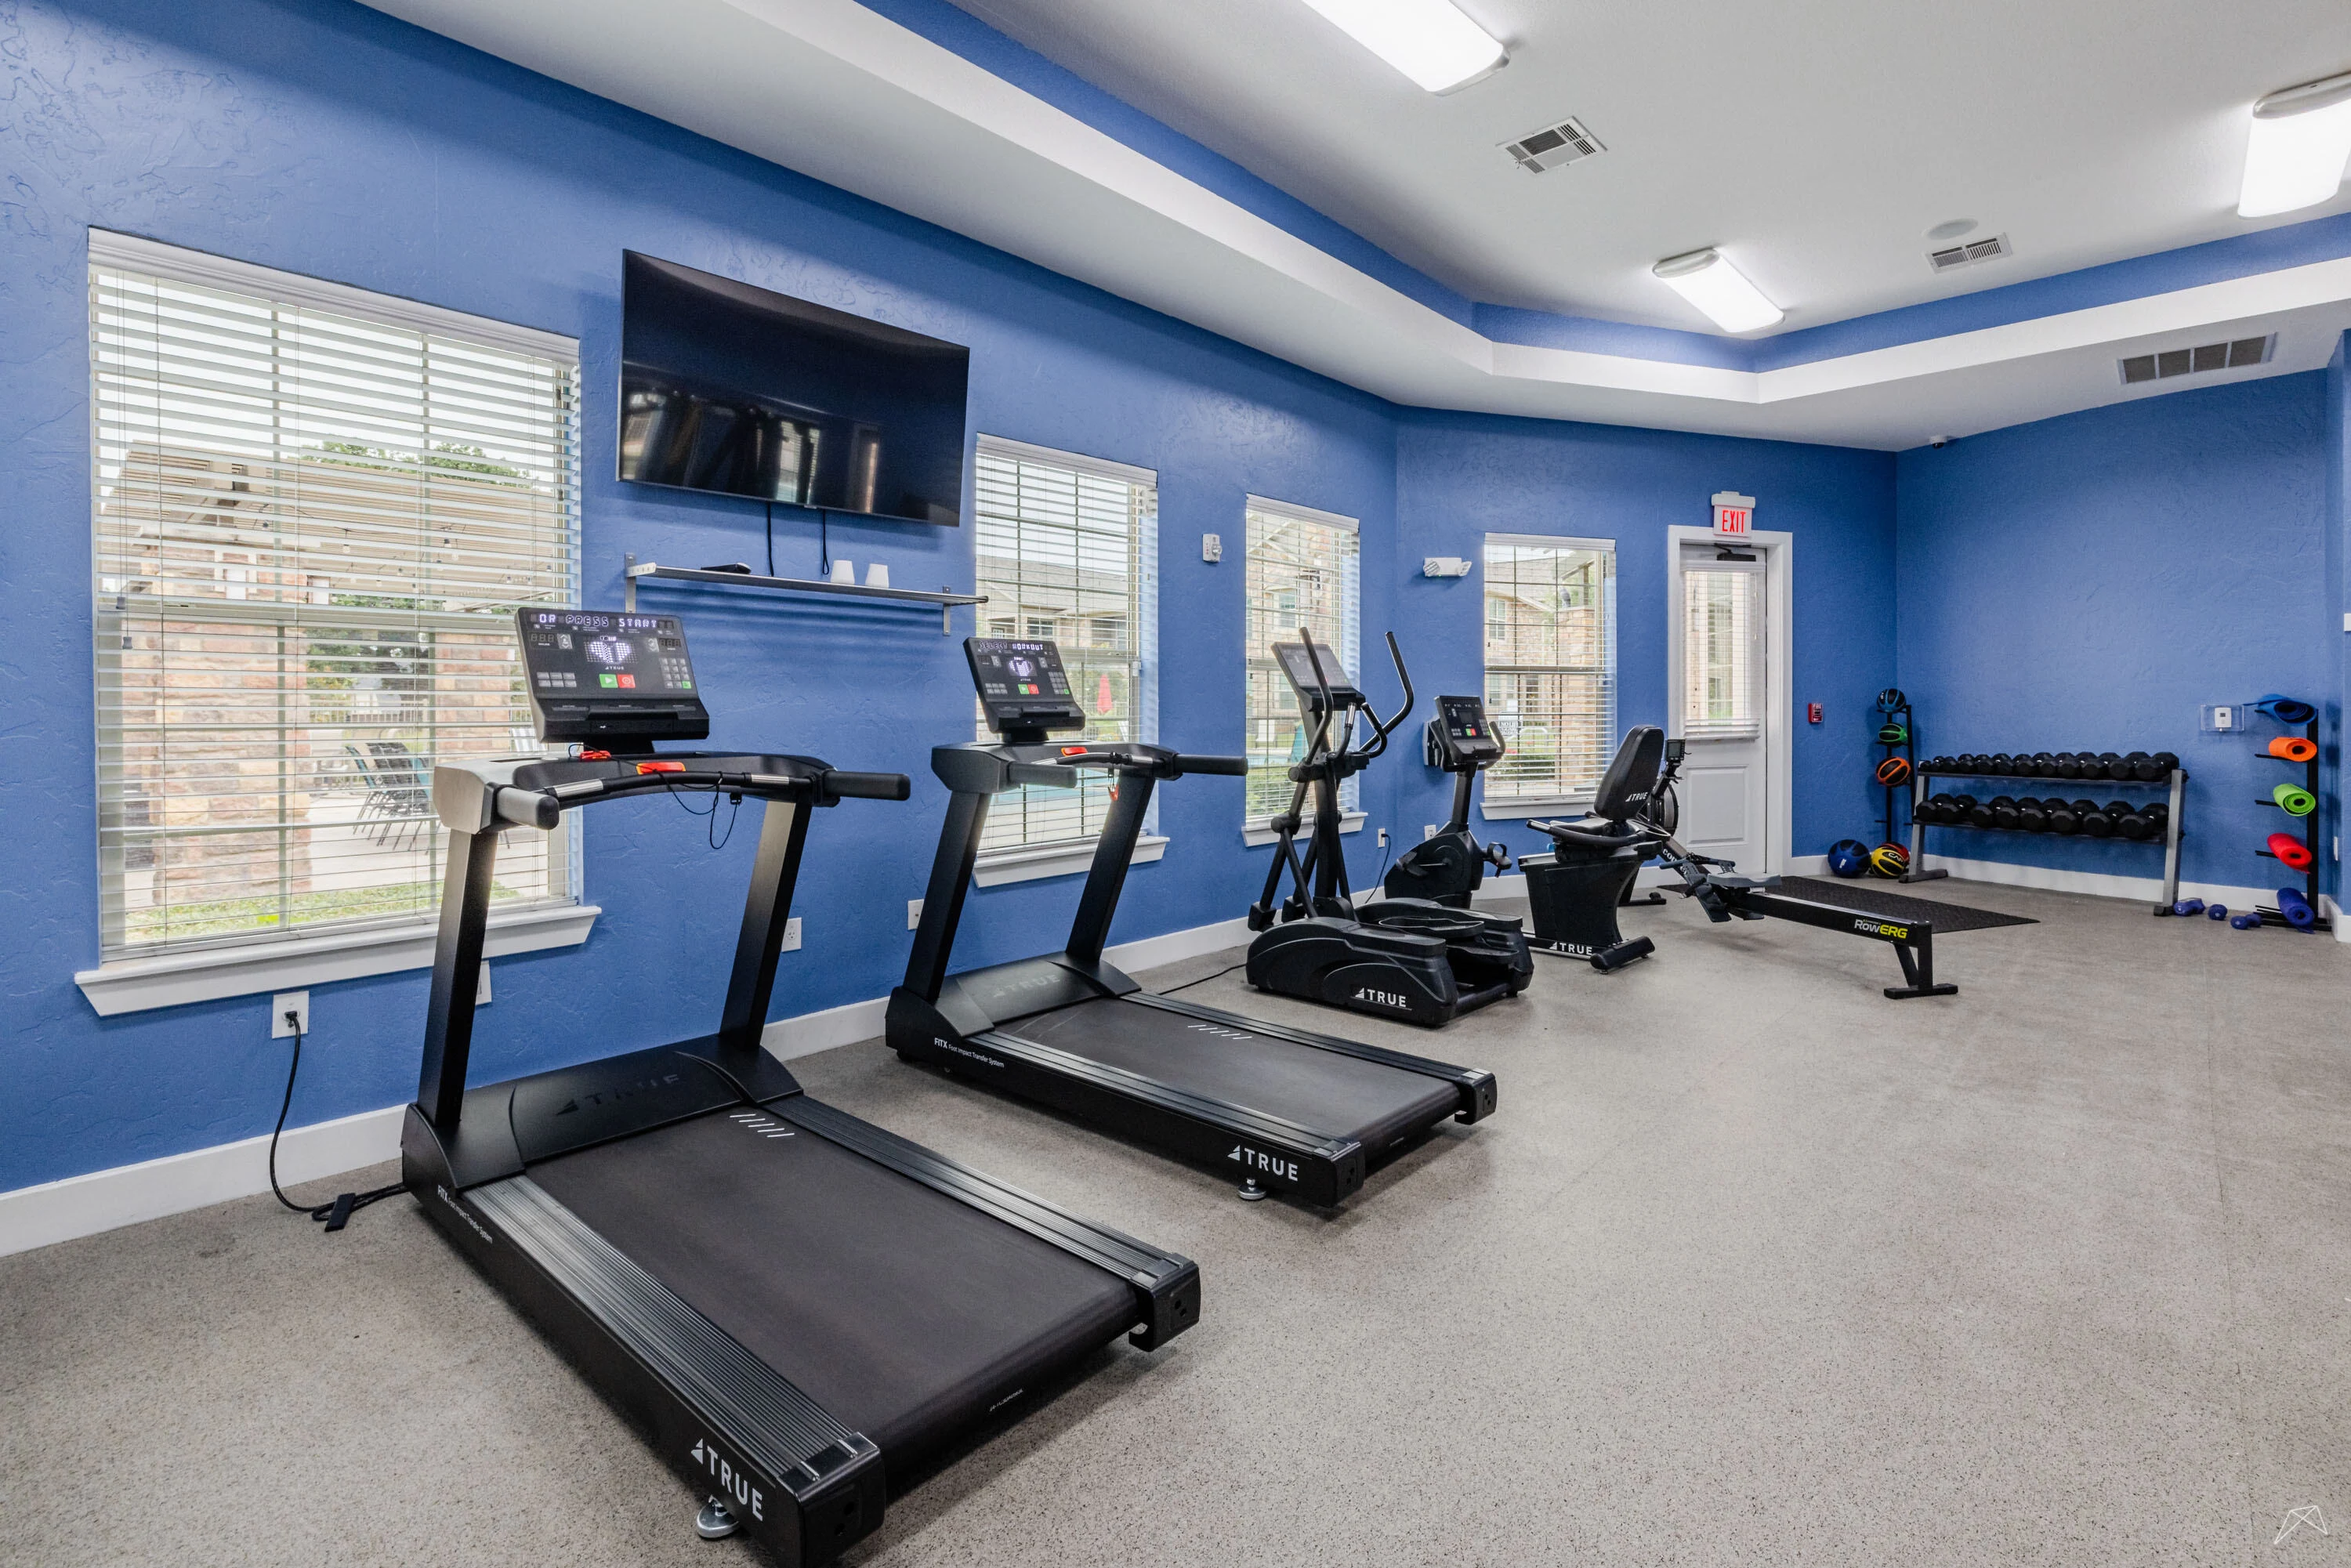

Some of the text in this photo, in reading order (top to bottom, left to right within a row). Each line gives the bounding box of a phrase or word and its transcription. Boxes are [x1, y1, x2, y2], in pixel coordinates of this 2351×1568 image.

[1722, 509, 1746, 533] EXIT
[539, 614, 556, 623] OR
[565, 614, 608, 627] PRESS
[618, 617, 657, 628] START
[1631, 791, 1648, 802] TRUE
[1854, 918, 1908, 939] RowERG
[1559, 942, 1592, 956] TRUE
[1005, 974, 1060, 990] TRUE
[1367, 988, 1406, 1008] TRUE
[934, 1037, 1005, 1068] FITX Foot Impact Transfer System
[585, 1074, 679, 1106] TE
[1244, 1147, 1299, 1182] TRUE
[707, 1445, 763, 1522] TRUE
